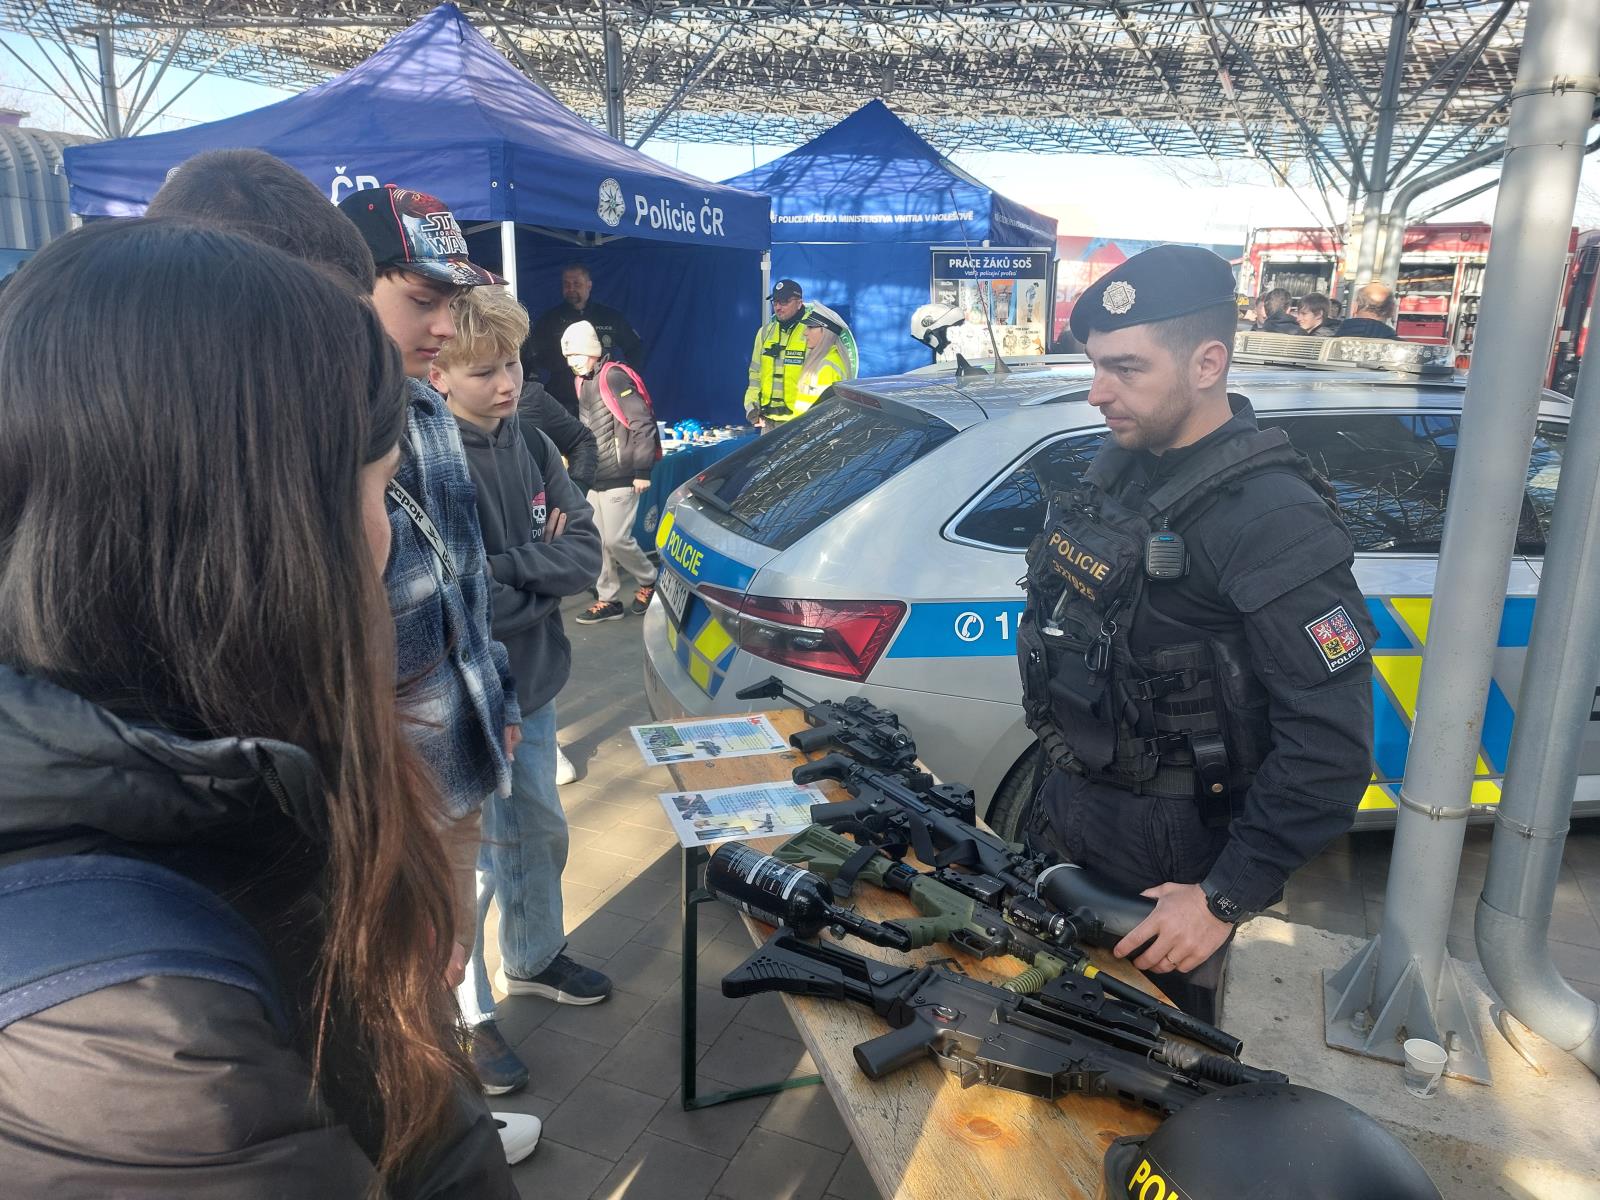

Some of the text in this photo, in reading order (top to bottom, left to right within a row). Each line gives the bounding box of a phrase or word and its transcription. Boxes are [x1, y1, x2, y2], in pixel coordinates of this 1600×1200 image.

[634, 194, 696, 233] Policie
[700, 197, 725, 237] ČR
[839, 213, 893, 223] MINISTERSTVA
[894, 214, 923, 223] VNITRA
[949, 256, 1032, 269] PRÁCE ŽÁKŮ SOŠ
[666, 530, 704, 577] POLICIE
[1048, 532, 1110, 581] POLICIE
[1330, 644, 1363, 668] POLICIE
[1127, 1158, 1180, 1200] PO
